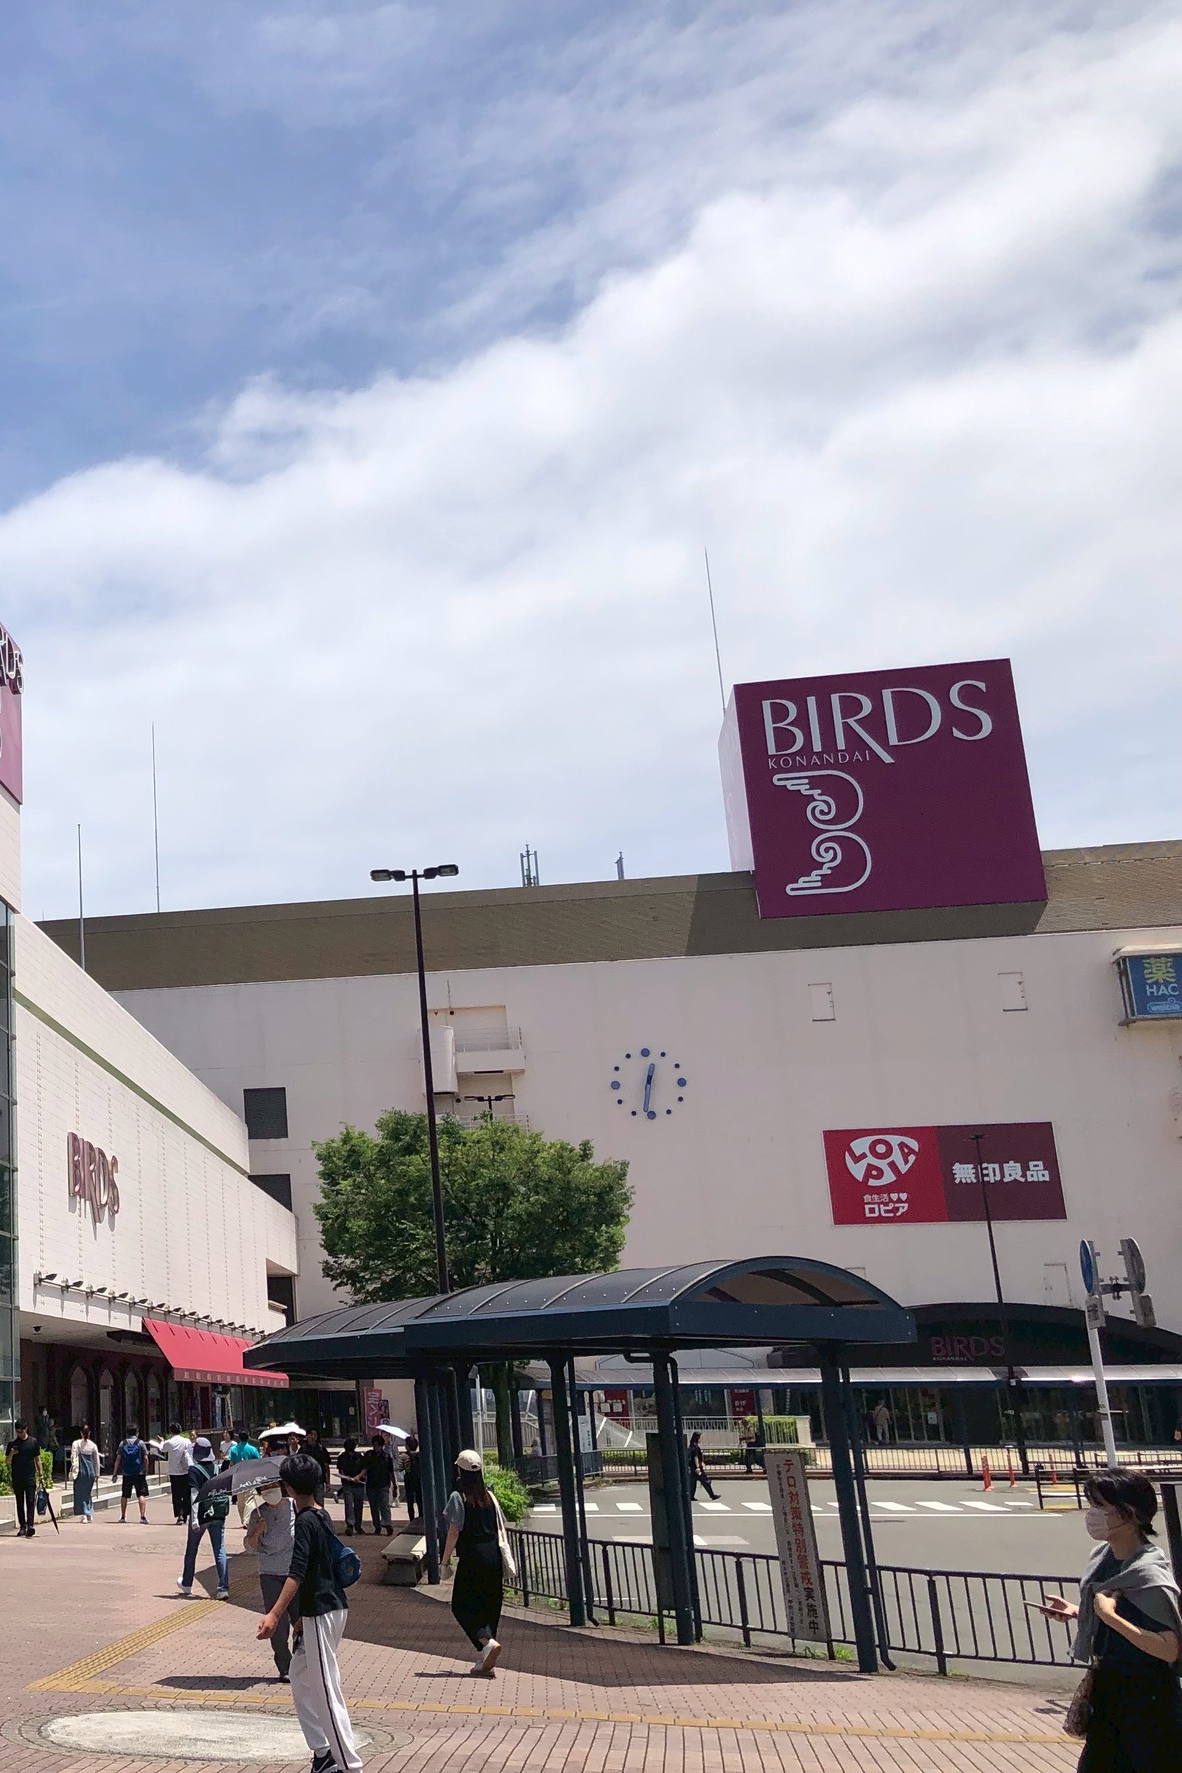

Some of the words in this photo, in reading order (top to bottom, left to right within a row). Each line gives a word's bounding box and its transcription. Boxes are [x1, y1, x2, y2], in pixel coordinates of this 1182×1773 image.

[762, 680, 993, 764] BIRDS
[768, 750, 871, 770] KONANDAI
[1143, 957, 1177, 983] 薬
[1146, 983, 1179, 997] HAC
[67, 1132, 119, 1224] BIRDS
[952, 1160, 1050, 1184] 無印良品
[864, 1203, 909, 1218] ロピア
[930, 1336, 1006, 1361] BIRDS
